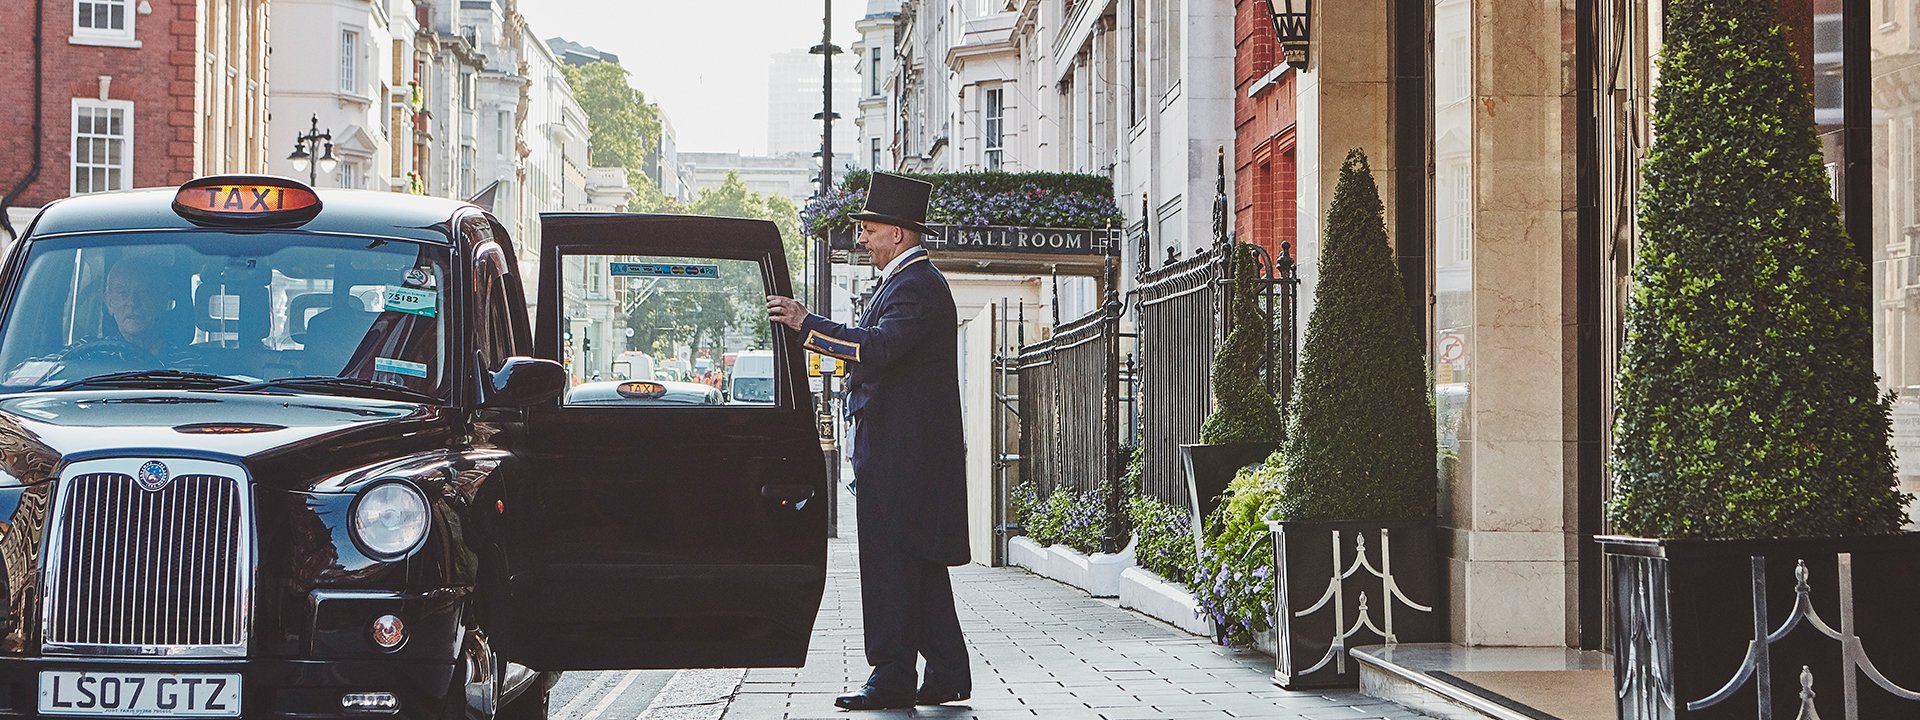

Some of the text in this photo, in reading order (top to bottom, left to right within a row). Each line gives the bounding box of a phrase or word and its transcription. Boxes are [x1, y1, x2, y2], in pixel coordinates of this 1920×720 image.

[205, 187, 285, 210] TAXI
[388, 292, 419, 304] 75182
[628, 384, 655, 393] TAXI
[52, 675, 227, 710] LS07 GTZ
